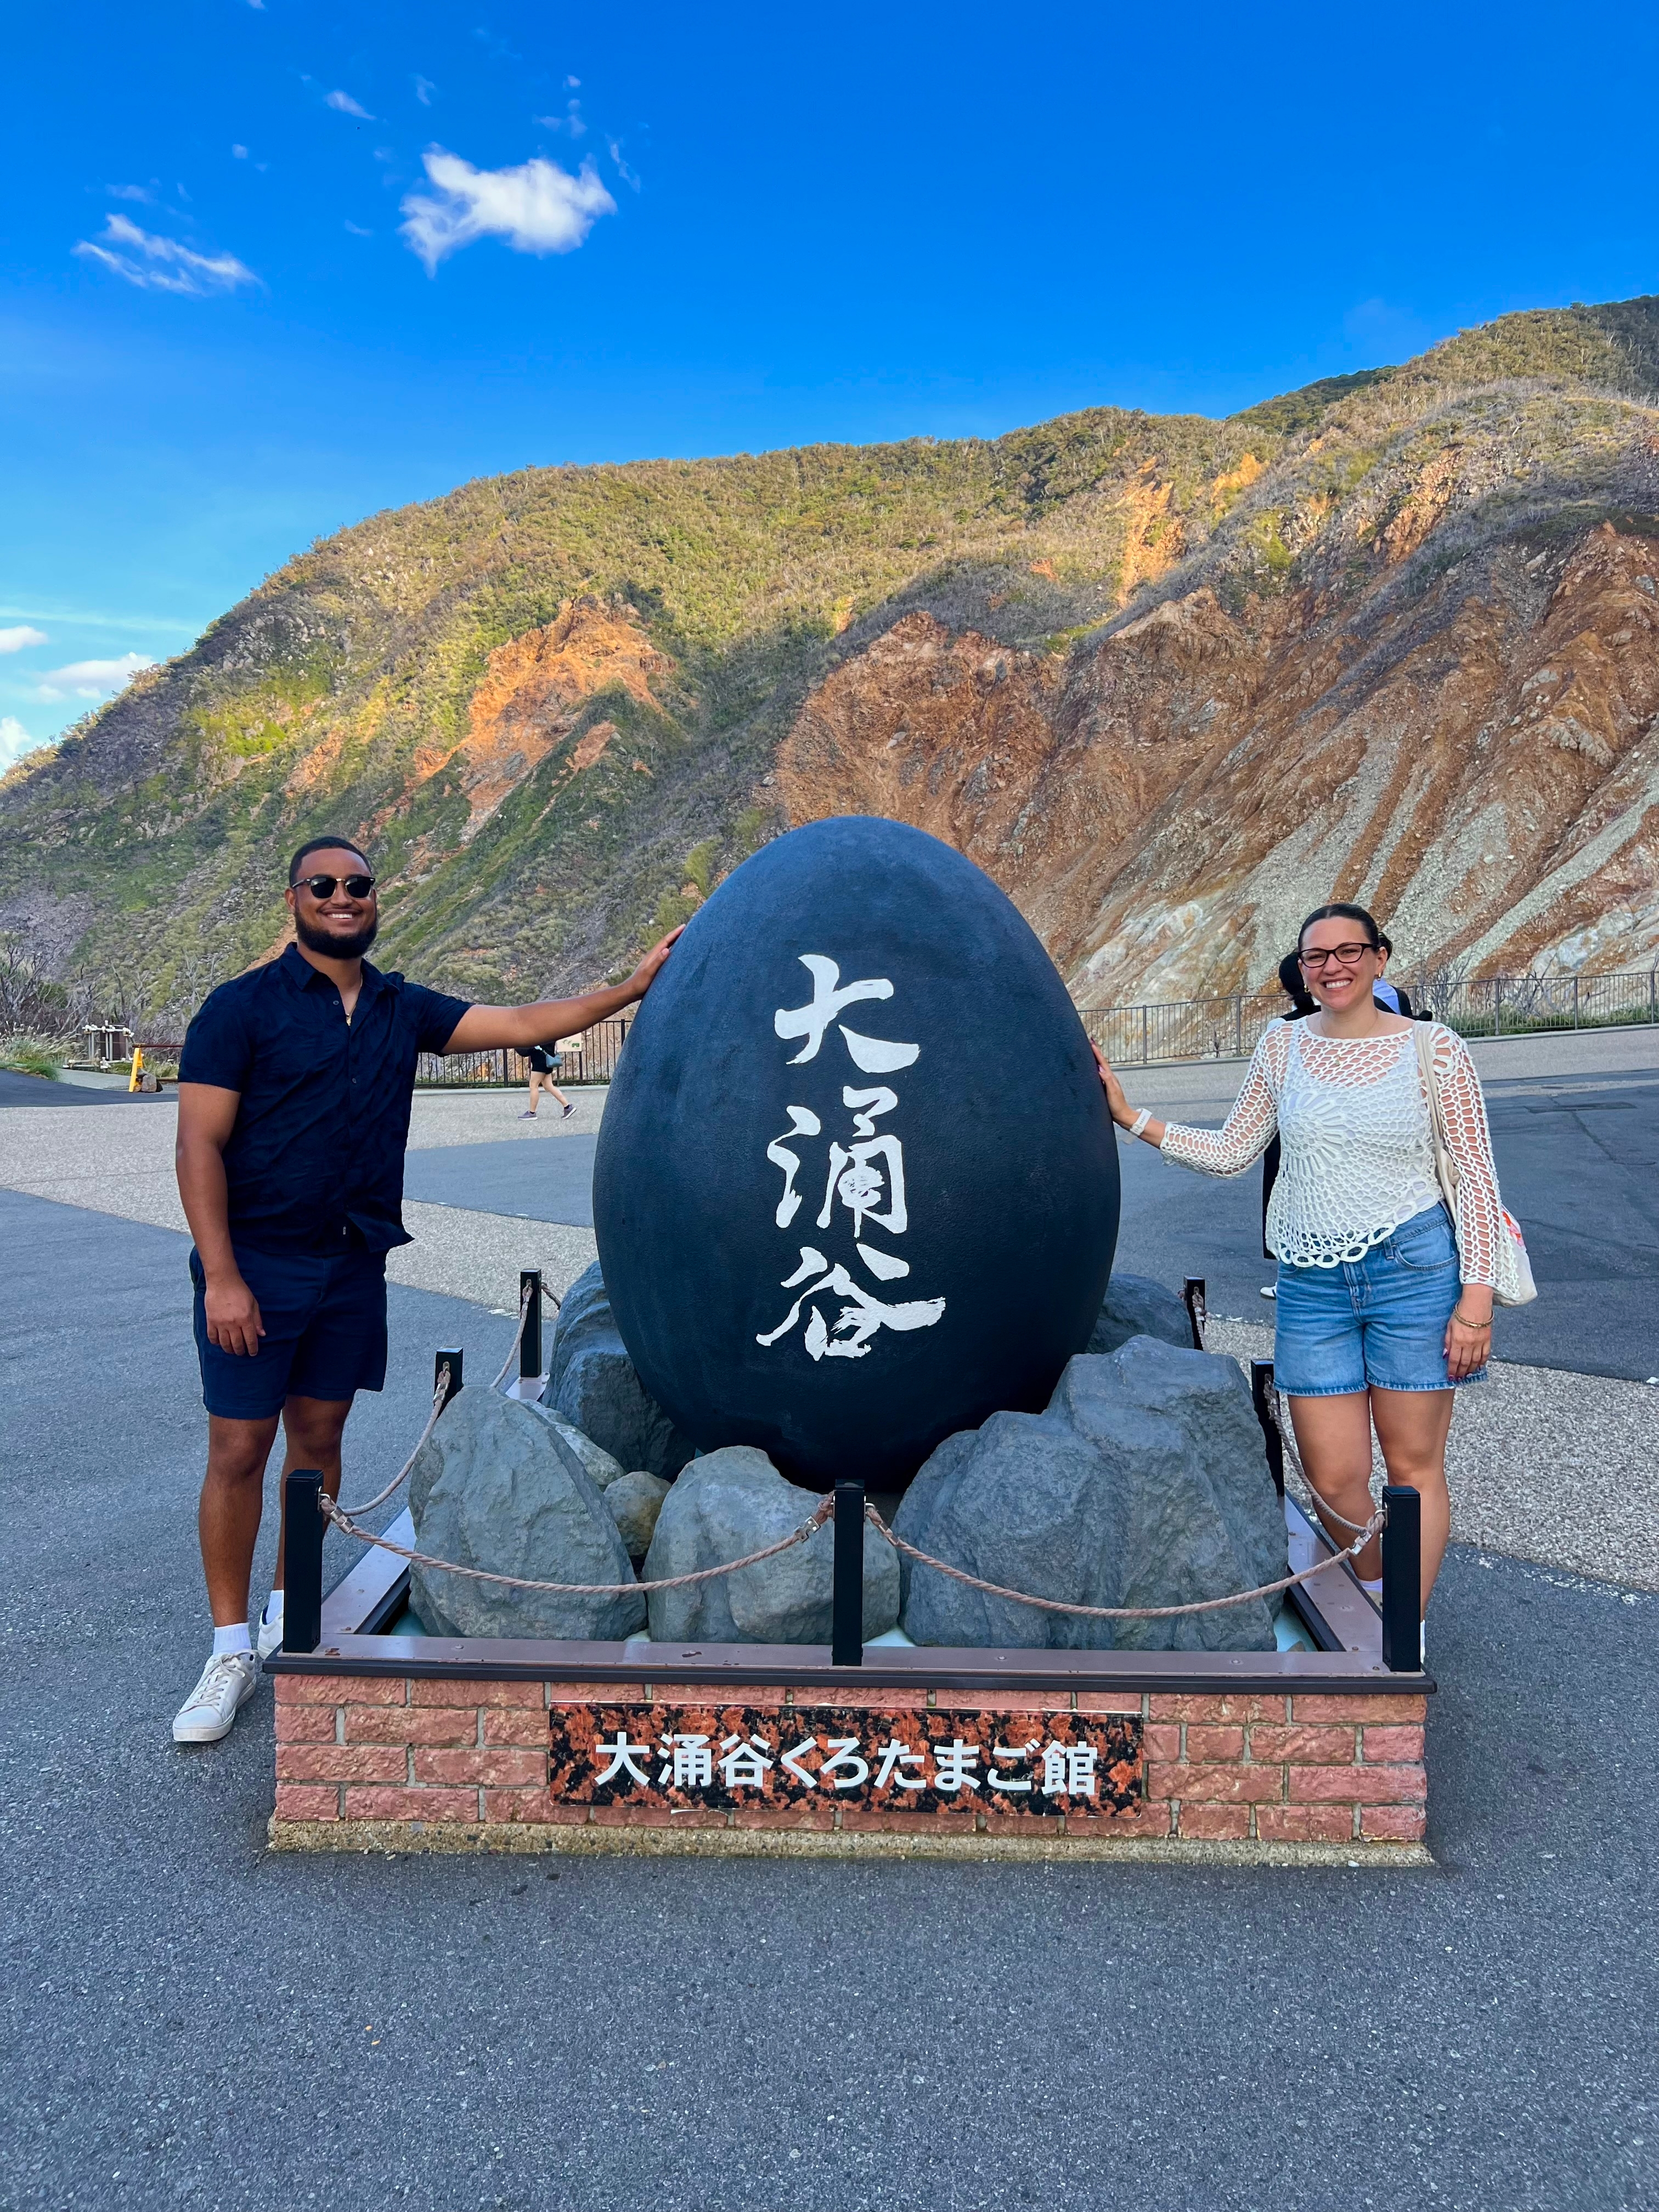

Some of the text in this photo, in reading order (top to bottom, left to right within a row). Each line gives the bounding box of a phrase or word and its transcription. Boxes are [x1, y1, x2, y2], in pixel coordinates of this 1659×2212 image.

[756, 955, 946, 1361] 大涌谷
[594, 1731, 1097, 1795] 大涌谷くろたまご館
